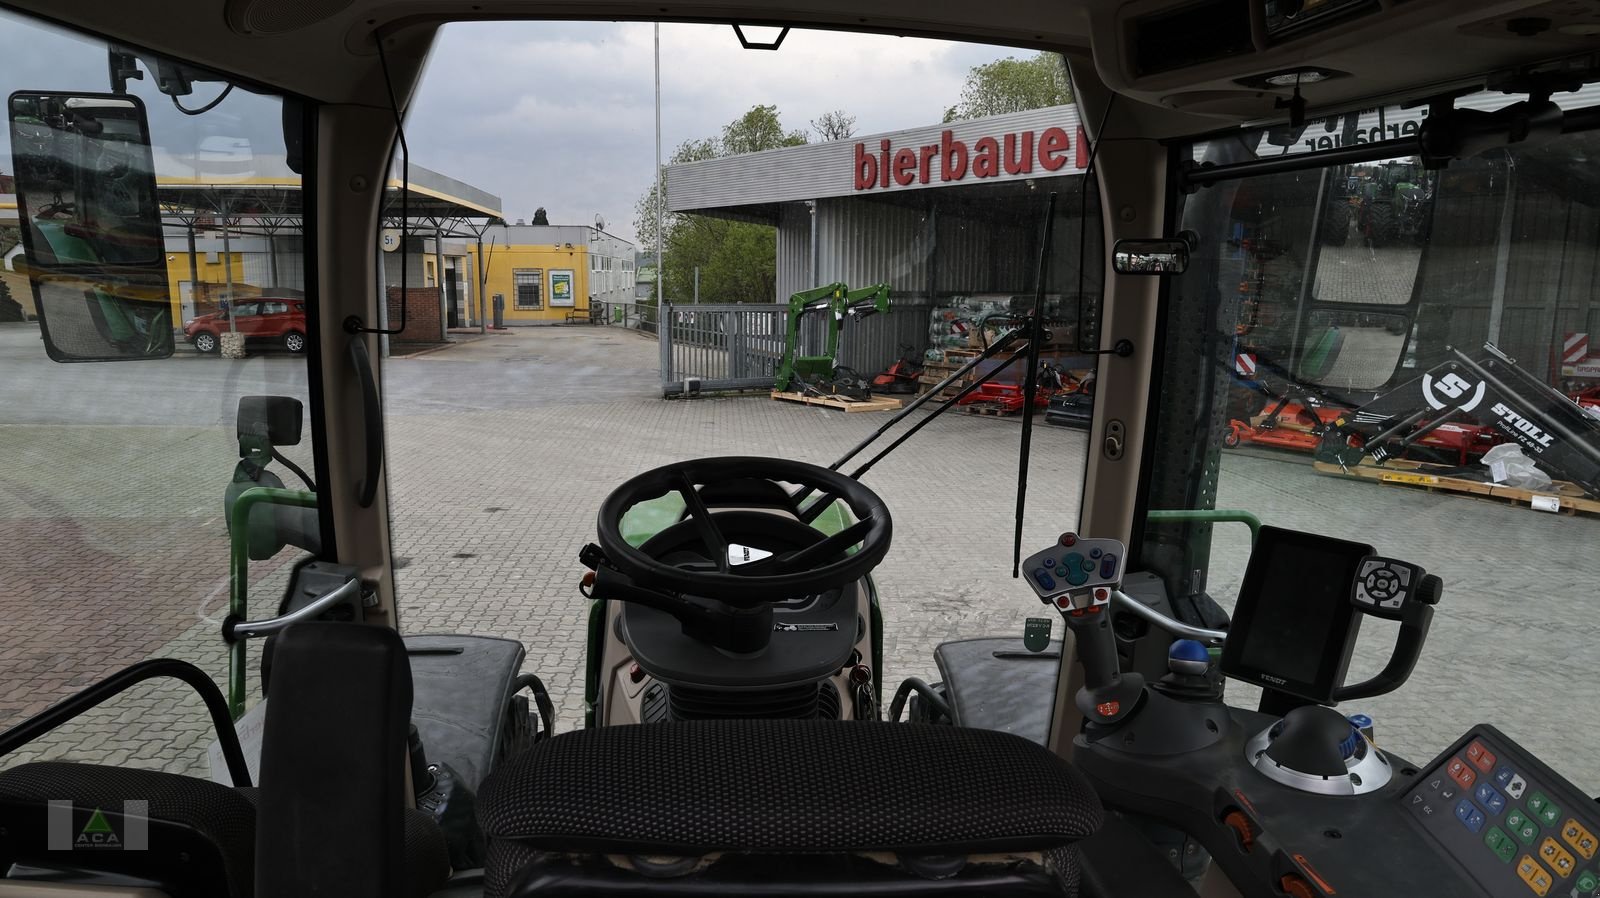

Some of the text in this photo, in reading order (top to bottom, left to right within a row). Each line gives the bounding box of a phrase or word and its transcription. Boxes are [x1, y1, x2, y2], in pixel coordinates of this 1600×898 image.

[1491, 403, 1554, 448] STOLL
[1517, 435, 1528, 445] FZ
[1261, 673, 1287, 685] FENDT
